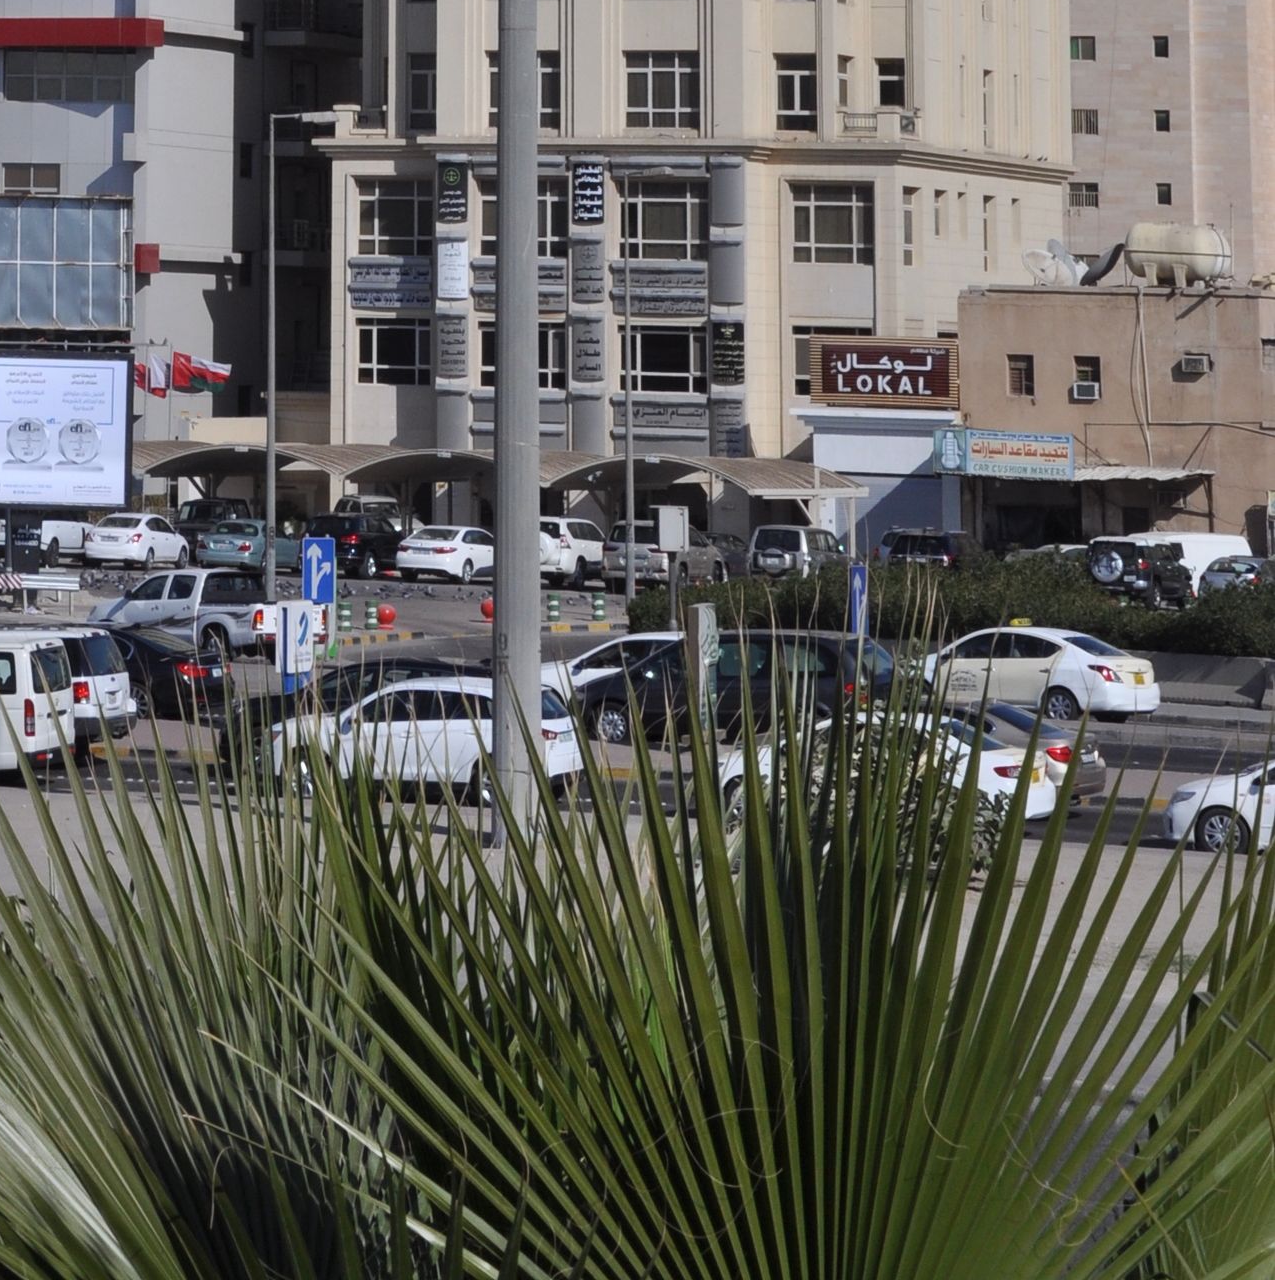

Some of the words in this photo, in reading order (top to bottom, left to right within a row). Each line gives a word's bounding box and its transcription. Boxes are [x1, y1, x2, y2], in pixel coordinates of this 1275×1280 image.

[575, 165, 603, 176] الدكتور
[574, 174, 603, 186] المحامي
[574, 185, 603, 196] فهد
[574, 196, 603, 208] سليمان
[837, 352, 933, 374] لوكال
[837, 373, 933, 395] LOKAL
[633, 407, 668, 419] العنزي
[670, 408, 706, 420] ابتسام
[971, 441, 1007, 459] السيارات
[1008, 442, 1038, 458] مقاعد
[1039, 446, 1069, 463] تنجيد
[972, 463, 990, 472] CAR
[991, 464, 1028, 474] CUSHION
[1030, 466, 1067, 477] MAKERS
